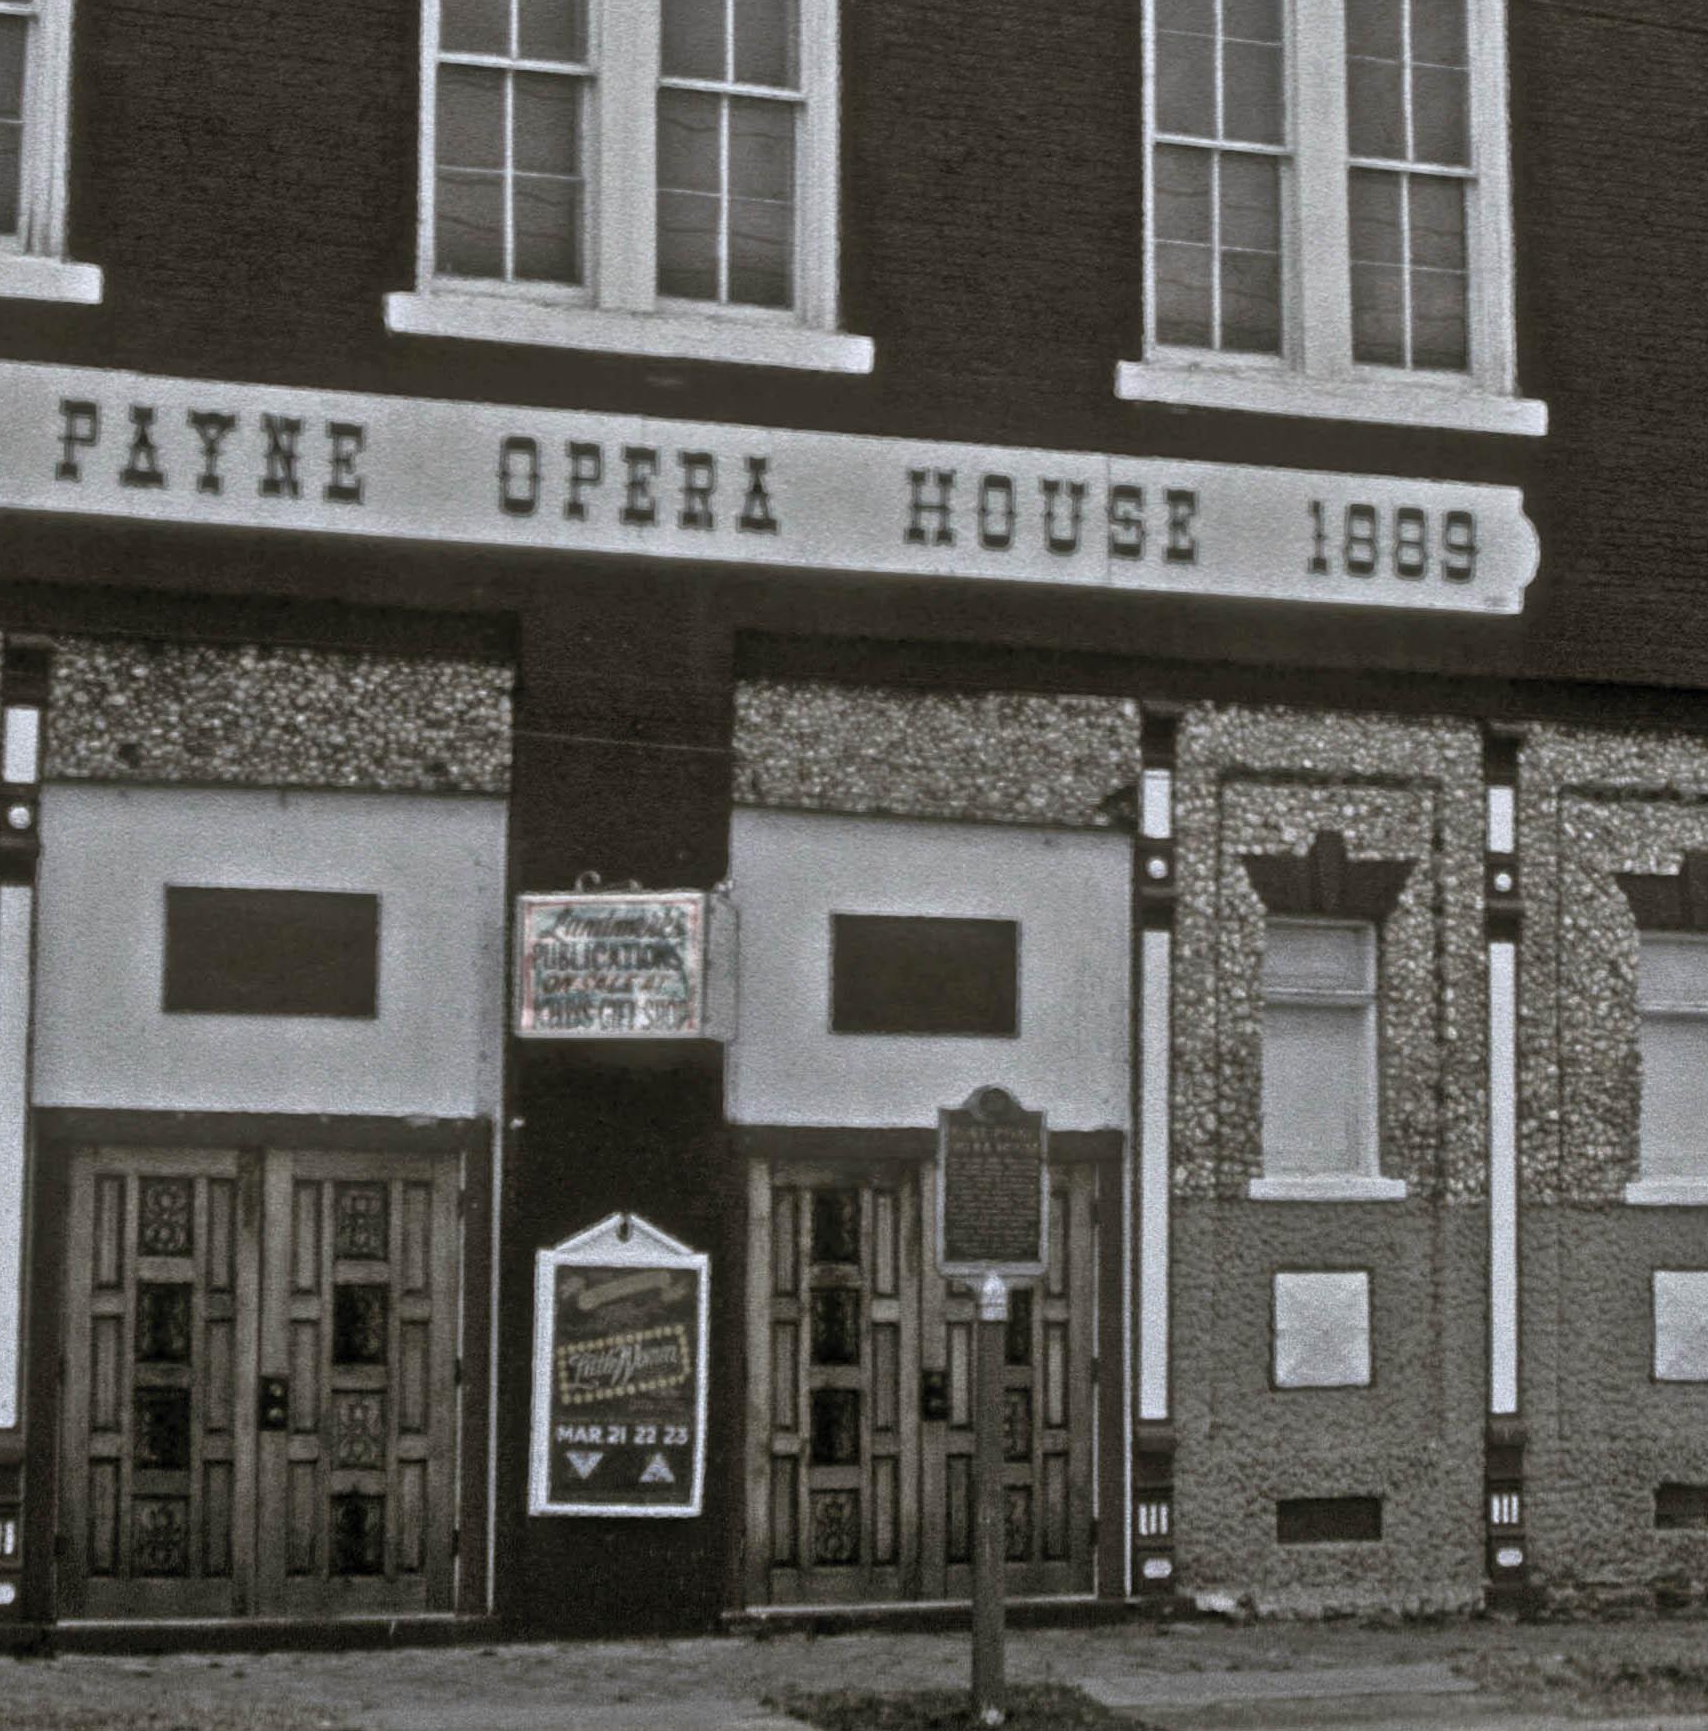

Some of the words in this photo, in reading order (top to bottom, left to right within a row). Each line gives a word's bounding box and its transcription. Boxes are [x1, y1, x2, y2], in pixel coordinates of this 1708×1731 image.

[55, 399, 368, 506] PAYNE
[497, 436, 780, 536] OPERA
[905, 468, 1200, 566] HOUSE
[1305, 499, 1480, 583] 1889
[533, 941, 684, 972] PUBLICATIONS
[607, 1425, 628, 1445] 21
[633, 1425, 658, 1445] 22
[662, 1425, 689, 1445] 23
